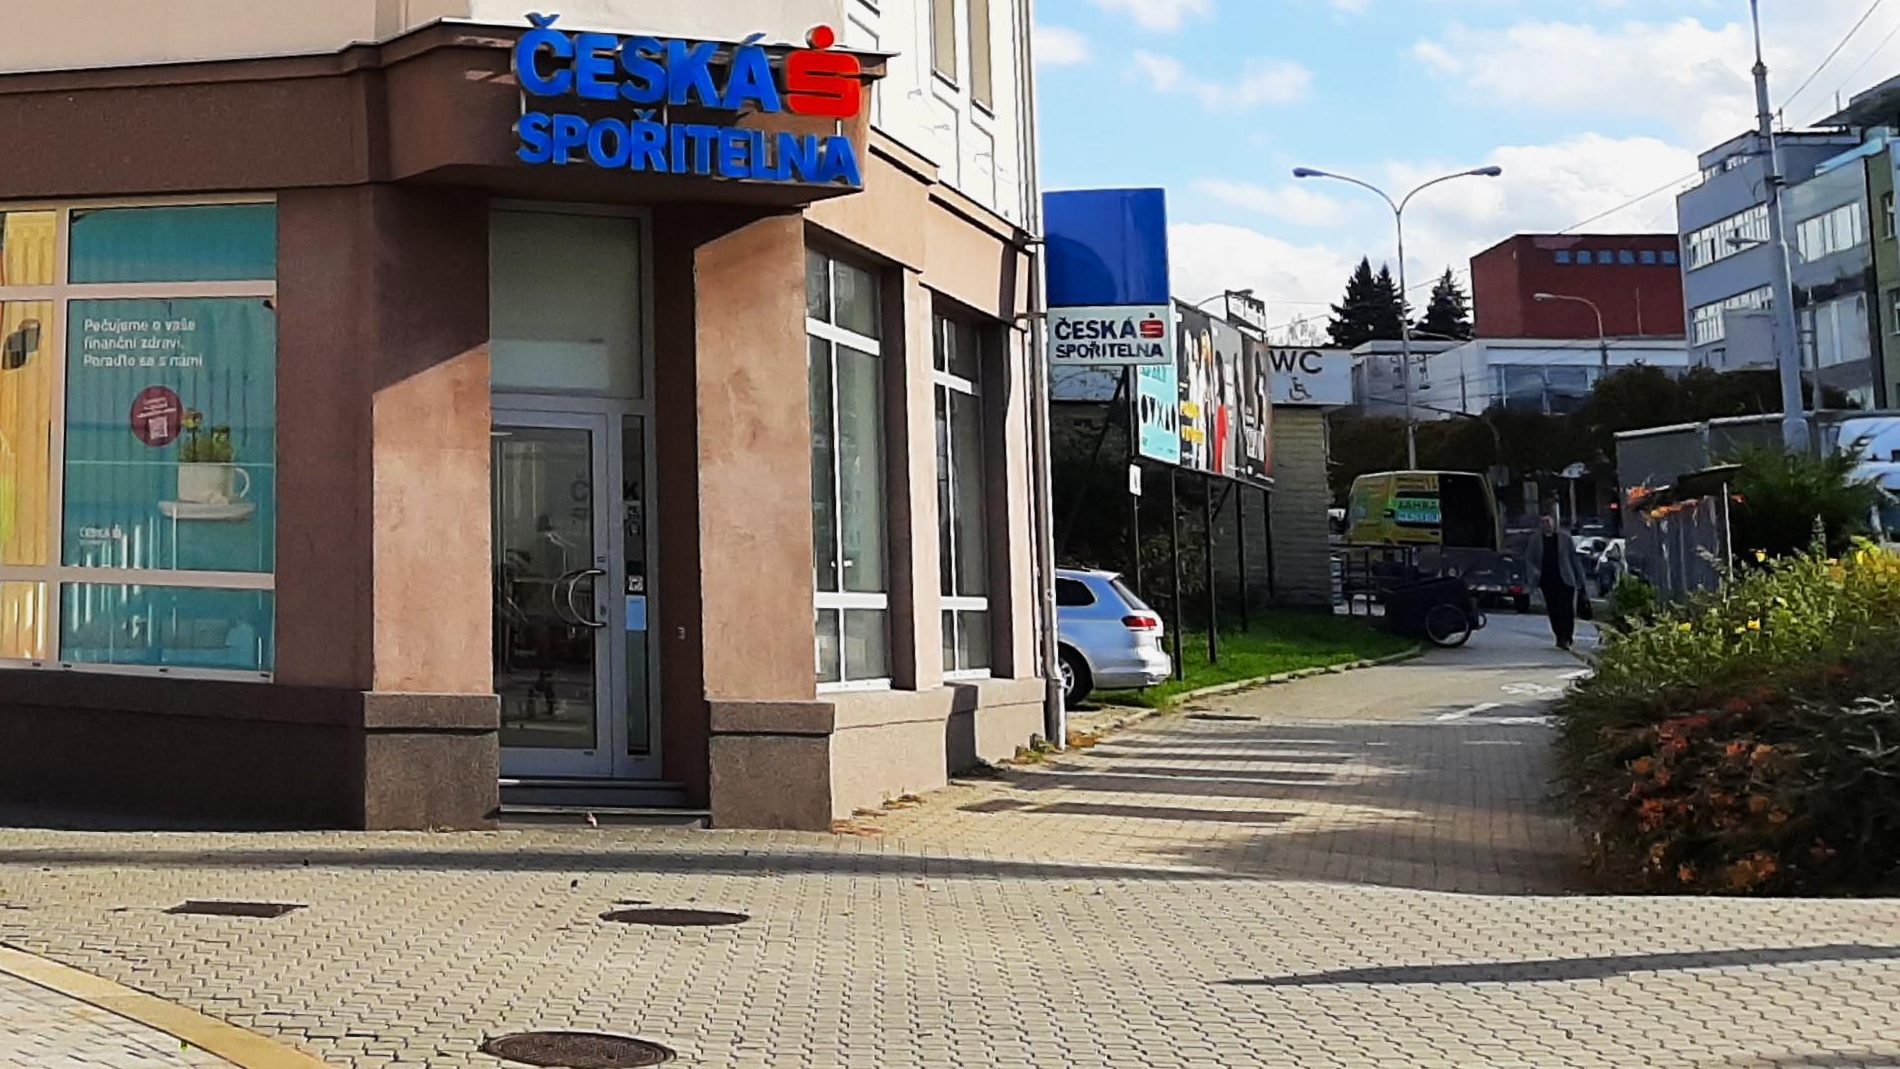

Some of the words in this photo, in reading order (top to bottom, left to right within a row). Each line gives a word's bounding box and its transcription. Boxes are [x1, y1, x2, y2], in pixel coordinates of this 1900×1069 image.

[512, 12, 782, 113] ČESKÁ
[514, 108, 864, 186] SPOŘITELNA
[152, 321, 161, 331] o
[1054, 316, 1137, 340] ČESKÁ
[1055, 341, 1164, 359] SPOŘITELNA
[1269, 350, 1323, 374] WC
